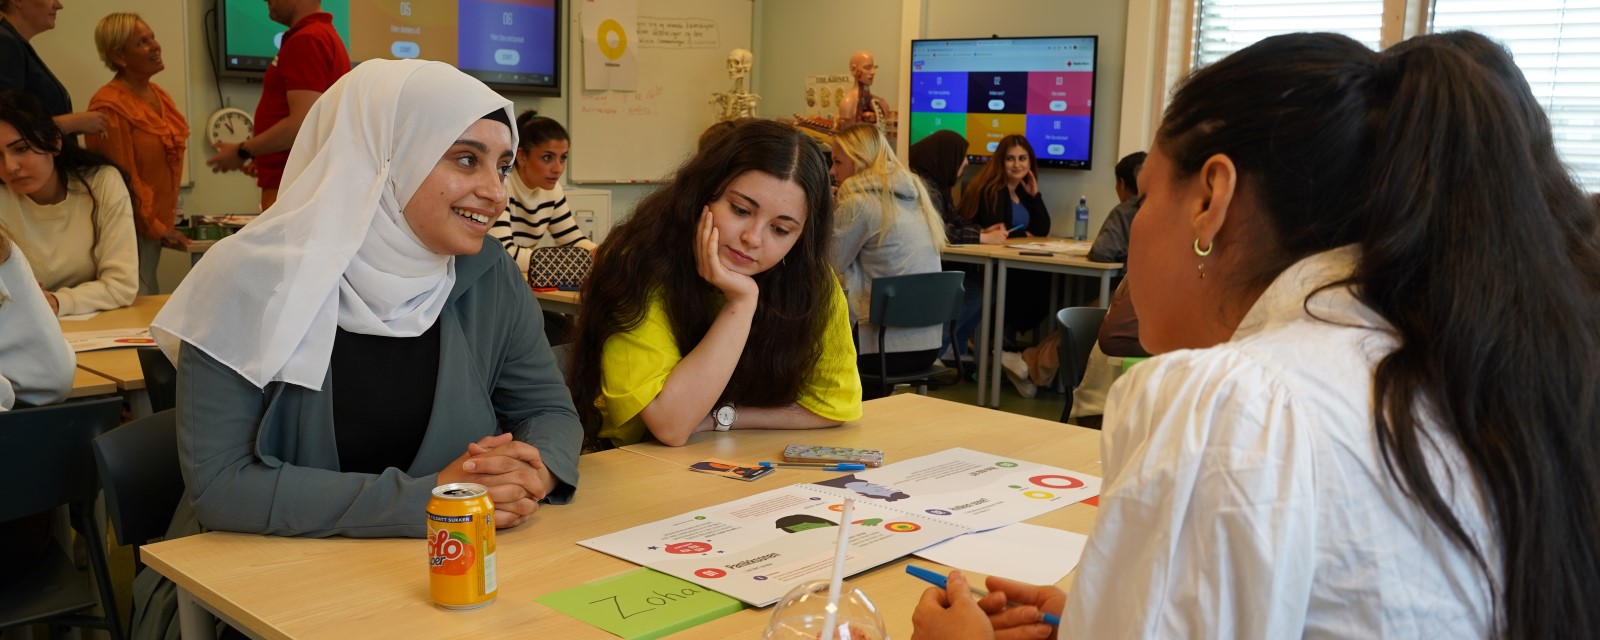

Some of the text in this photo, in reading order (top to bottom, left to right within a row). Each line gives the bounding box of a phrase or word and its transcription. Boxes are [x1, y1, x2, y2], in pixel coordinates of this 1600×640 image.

[400, 1, 411, 16] 05
[502, 12, 513, 25] 06
[427, 529, 463, 560] olo
[430, 556, 446, 570] per
